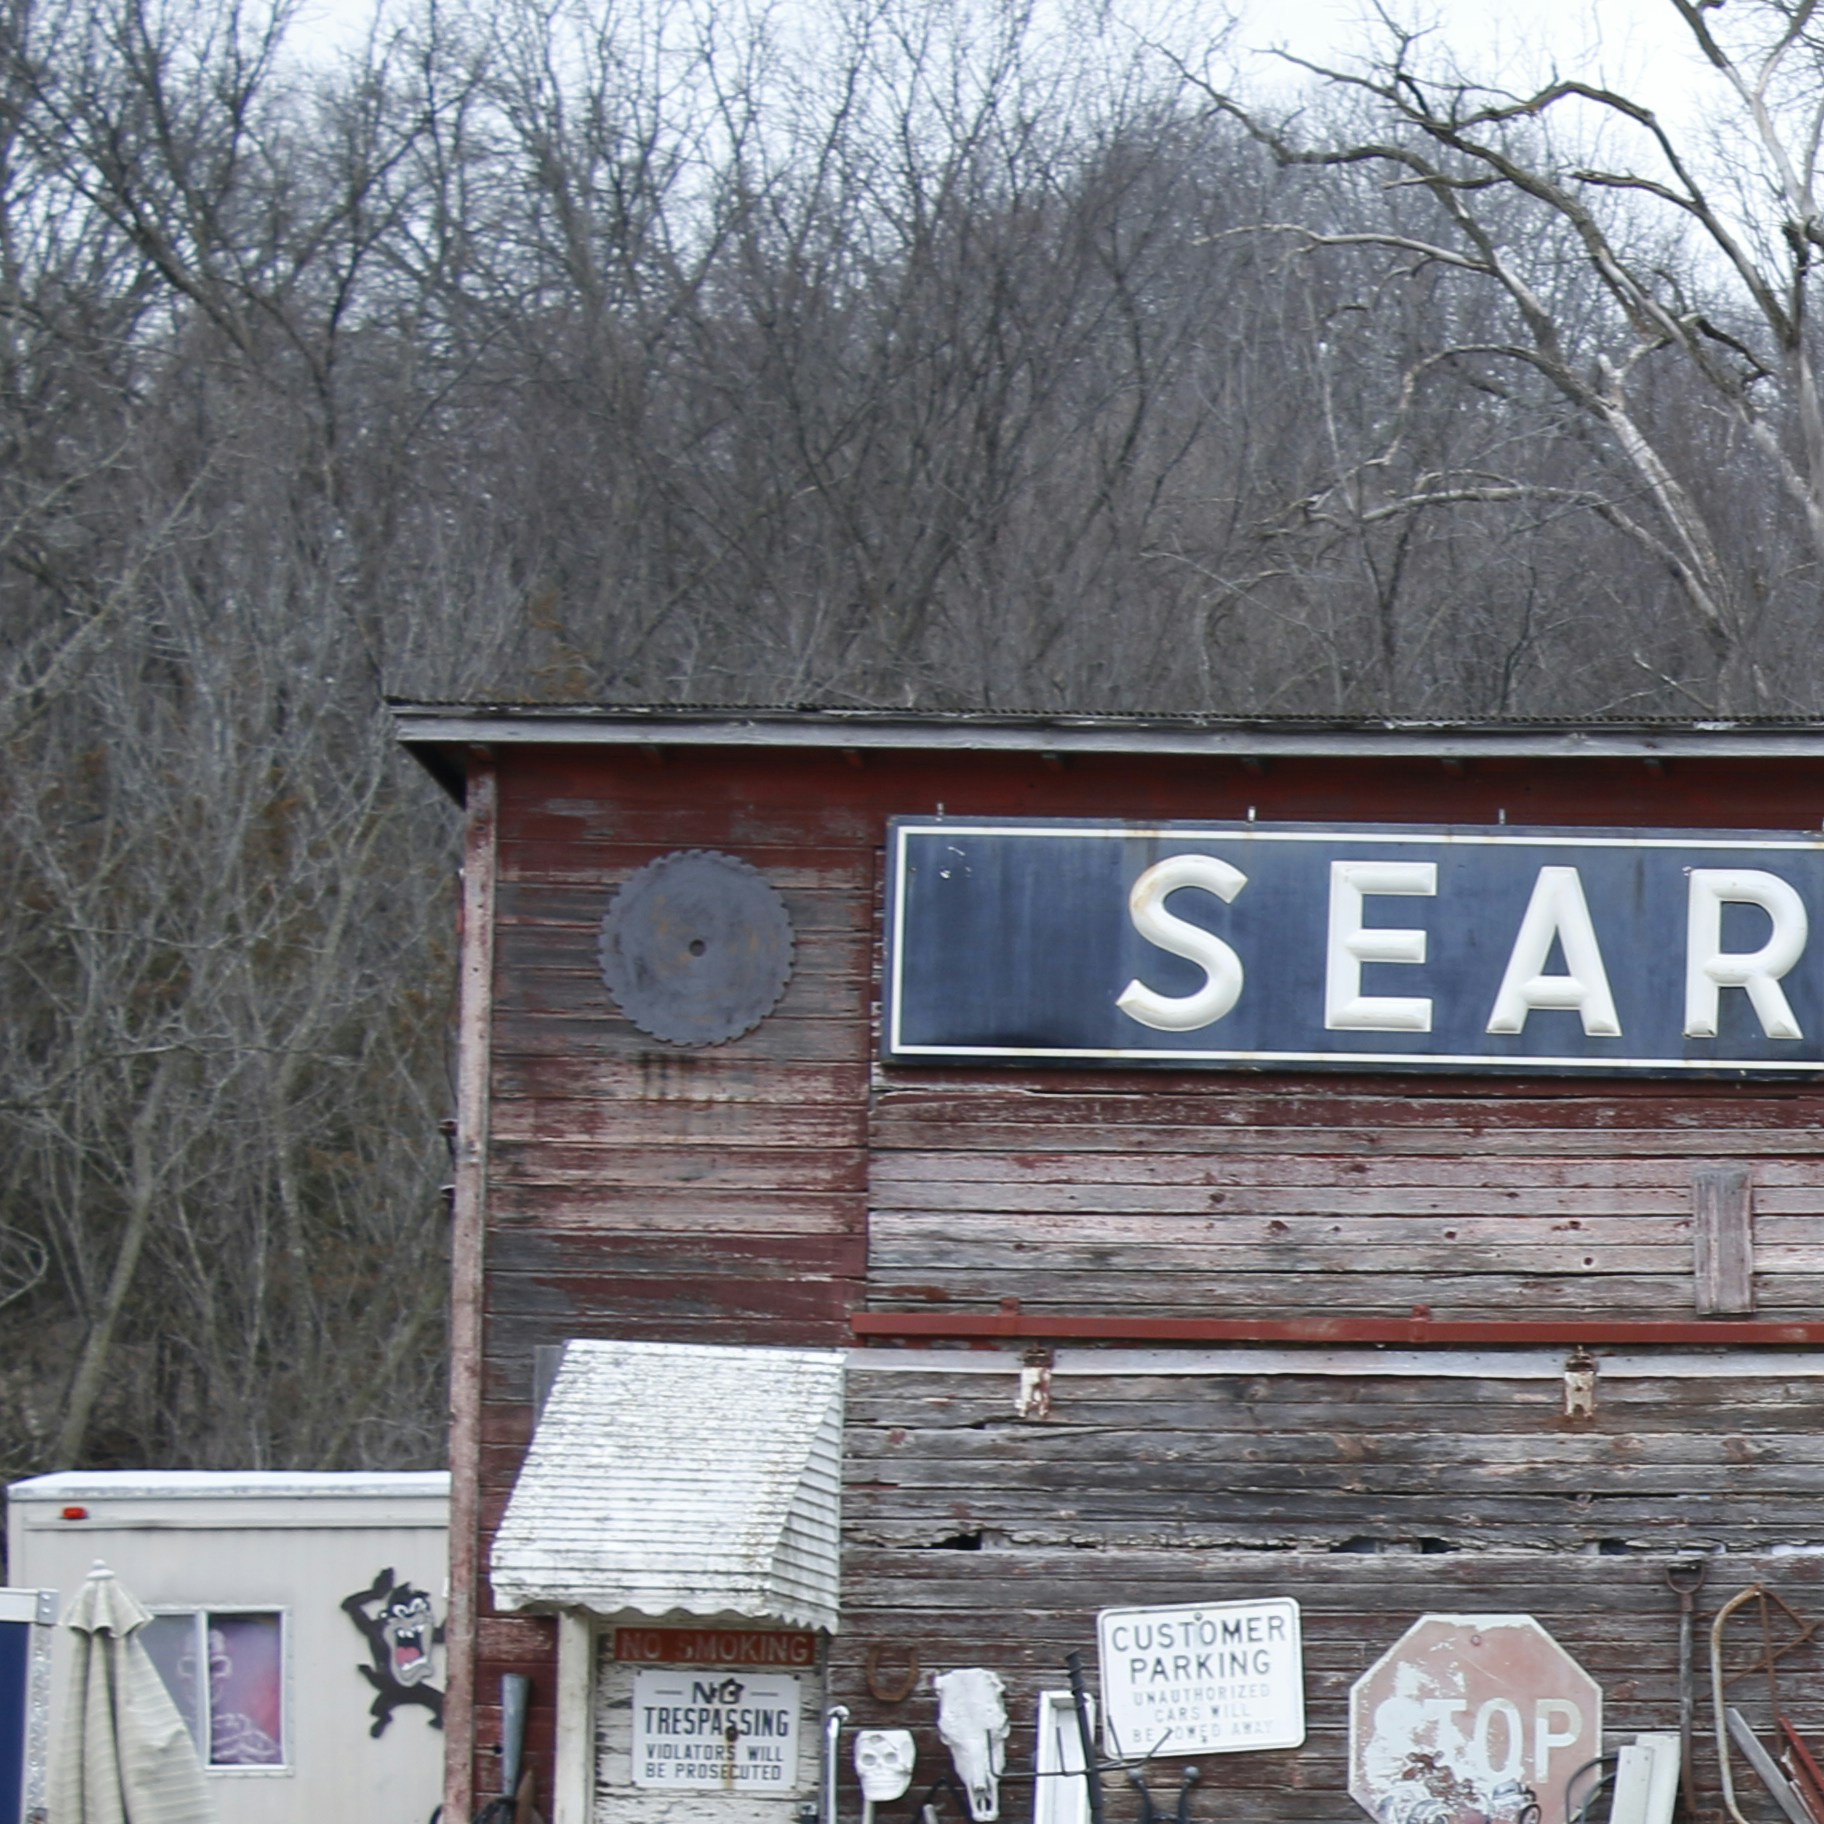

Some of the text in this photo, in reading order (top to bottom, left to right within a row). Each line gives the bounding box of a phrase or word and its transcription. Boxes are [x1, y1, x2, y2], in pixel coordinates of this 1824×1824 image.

[1112, 1615, 1286, 1652] CUSTOMER
[621, 1631, 808, 1662] NO SMOKING
[1130, 1650, 1271, 1684] PARKING
[692, 1680, 742, 1704] NO
[1133, 1682, 1271, 1707] UNAUTHORIZED
[643, 1706, 789, 1737] TRESPASSING
[1155, 1702, 1253, 1723] CARS WILL
[1132, 1727, 1156, 1743] BE
[646, 1743, 784, 1762] VIOLATORS WILL
[645, 1762, 782, 1781] BE PROSECUTED
